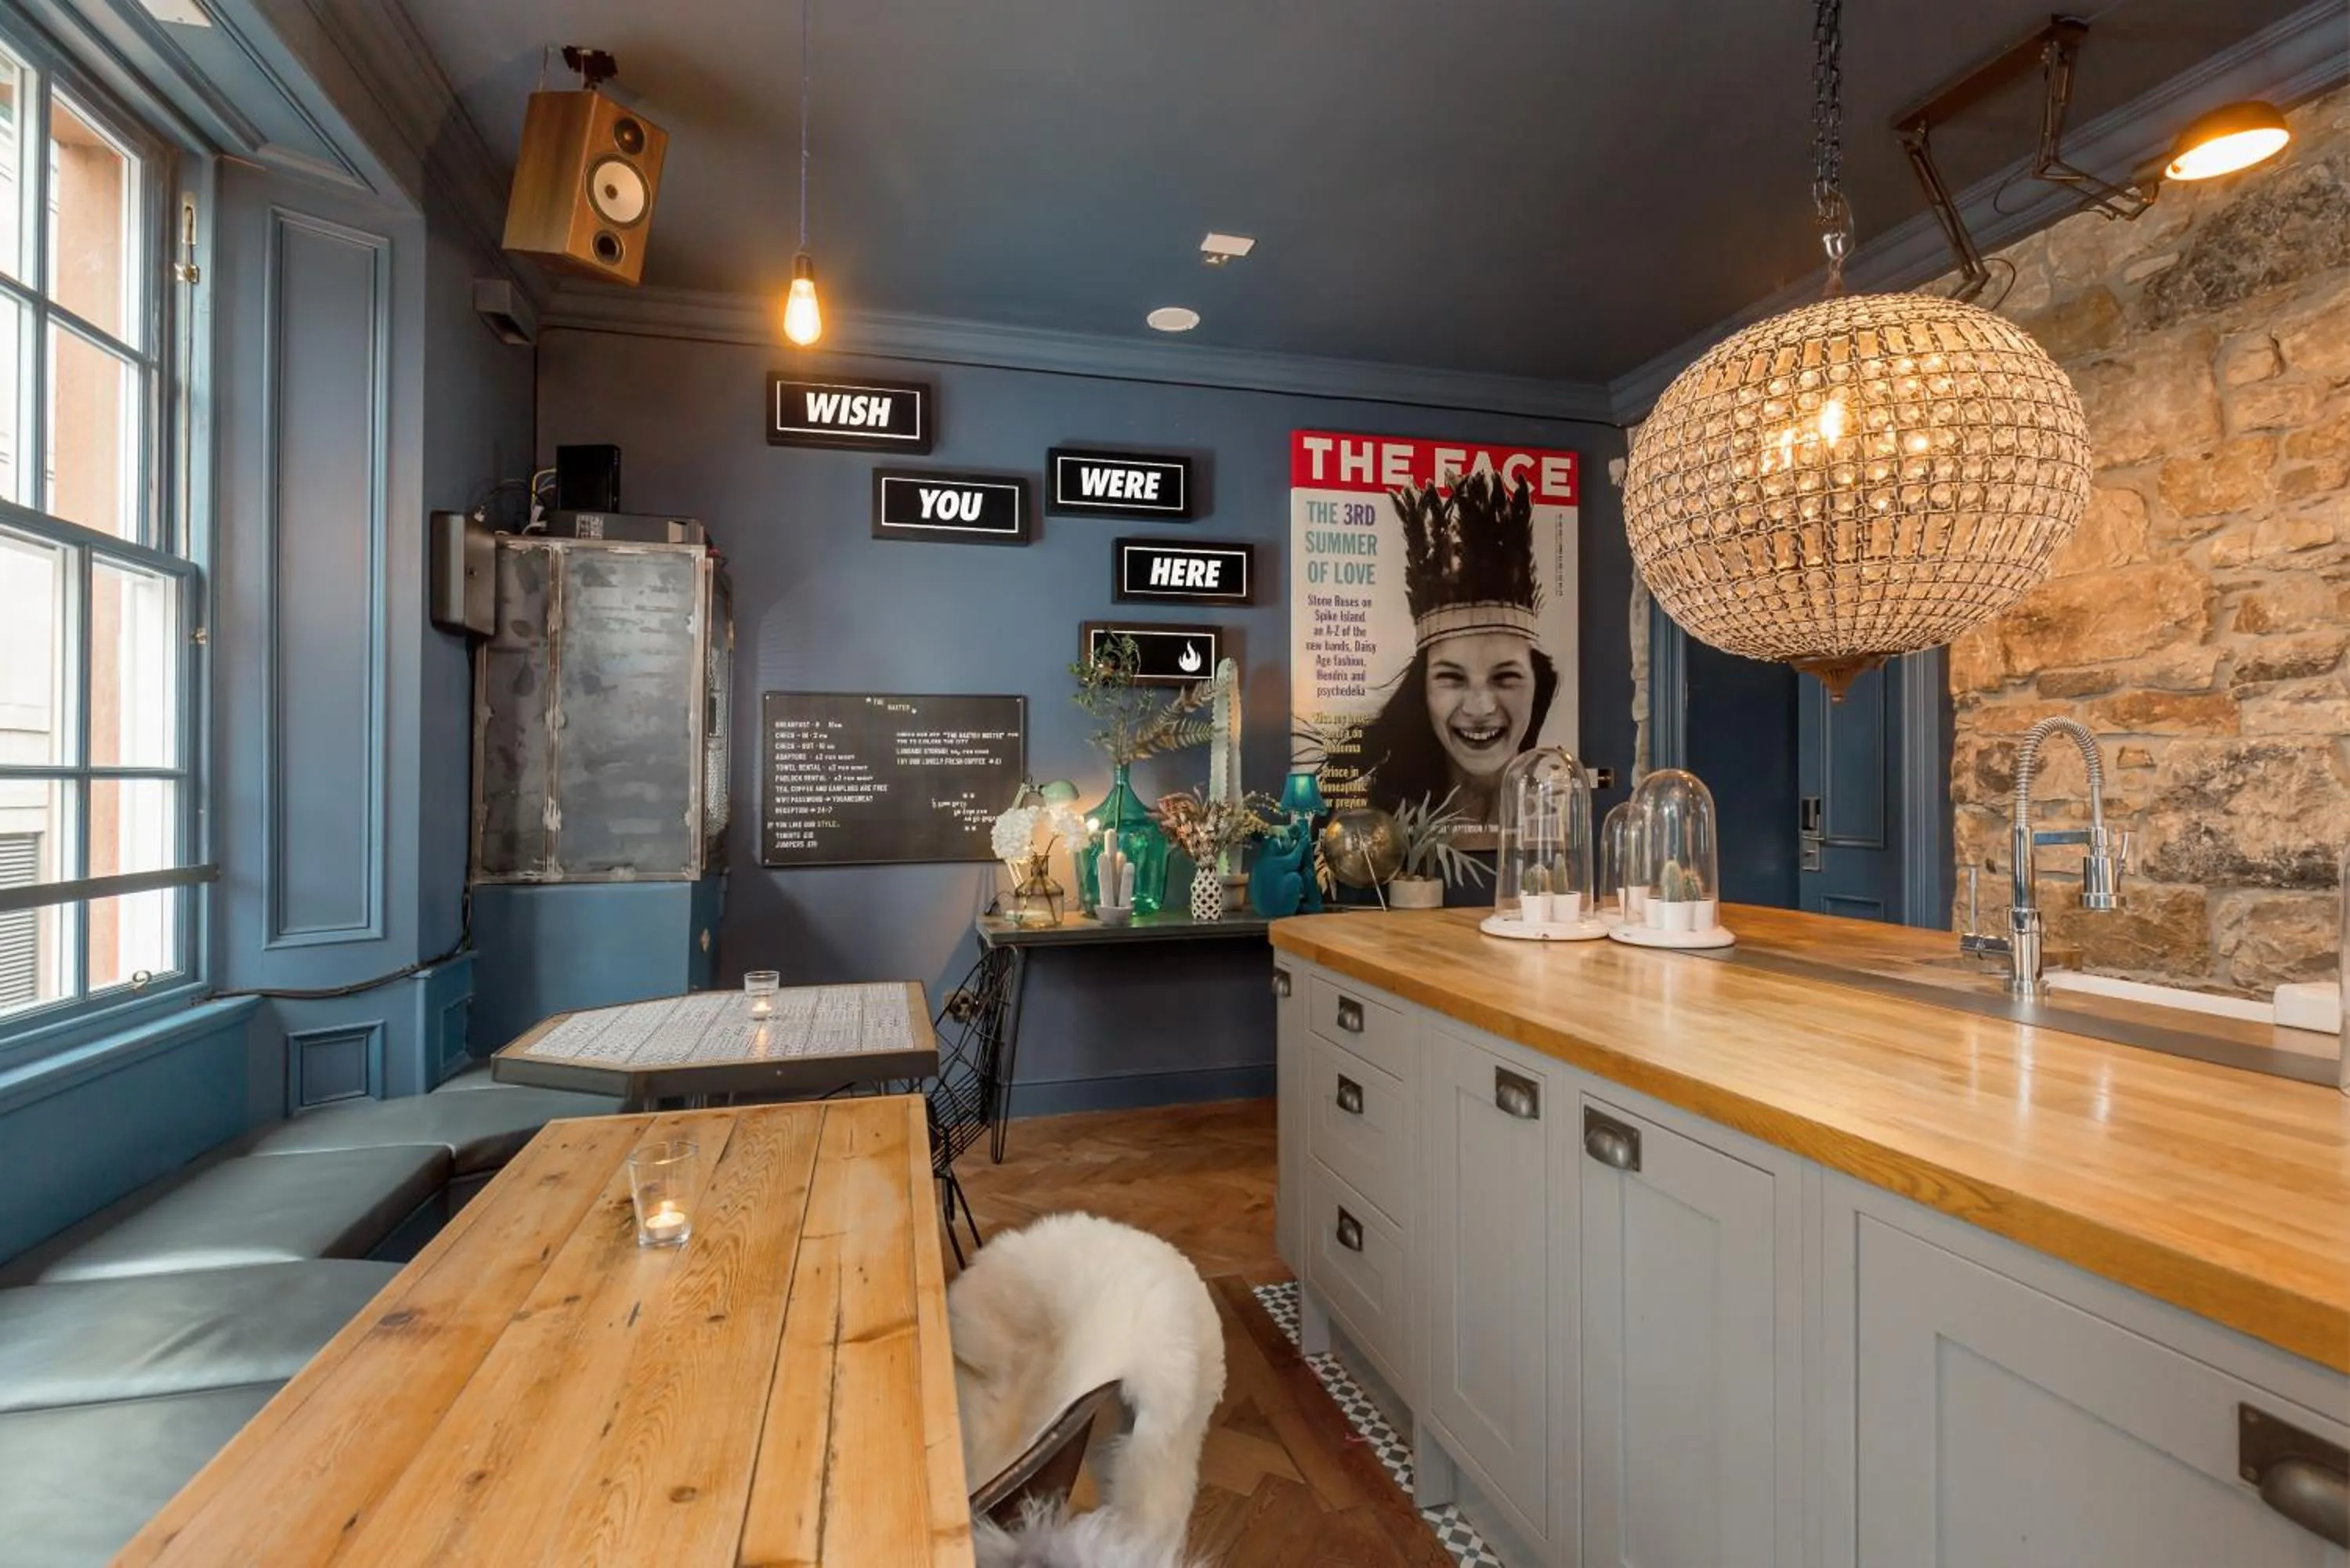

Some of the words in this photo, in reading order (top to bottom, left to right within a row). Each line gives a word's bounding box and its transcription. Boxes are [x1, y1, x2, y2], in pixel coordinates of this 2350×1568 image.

[806, 392, 892, 427] WISH
[1303, 436, 1414, 486] THE
[1434, 446, 1571, 497] FACE
[1080, 467, 1162, 500] WERE
[919, 488, 982, 521] YOU
[1306, 500, 1337, 524] THE
[1343, 503, 1376, 526] 3RD
[1305, 530, 1377, 556] SUMMER
[1149, 557, 1222, 588] HERE
[1307, 561, 1329, 583] OF
[1334, 562, 1376, 585] LOVE
[1307, 594, 1332, 607] Stone
[1334, 595, 1359, 608] Roses
[1361, 598, 1372, 608] on
[1315, 609, 1337, 623] Spike
[1340, 610, 1366, 623] Island
[1314, 627, 1324, 636] an
[1326, 624, 1340, 637] A-Z
[1342, 625, 1351, 637] of
[1353, 626, 1367, 637] the
[1306, 641, 1321, 651] new
[1354, 640, 1378, 655] Daisy
[1315, 654, 1332, 668] Age
[1316, 669, 1349, 681] Hendrix
[1350, 670, 1366, 681] and
[1317, 685, 1366, 698] psychedelia
